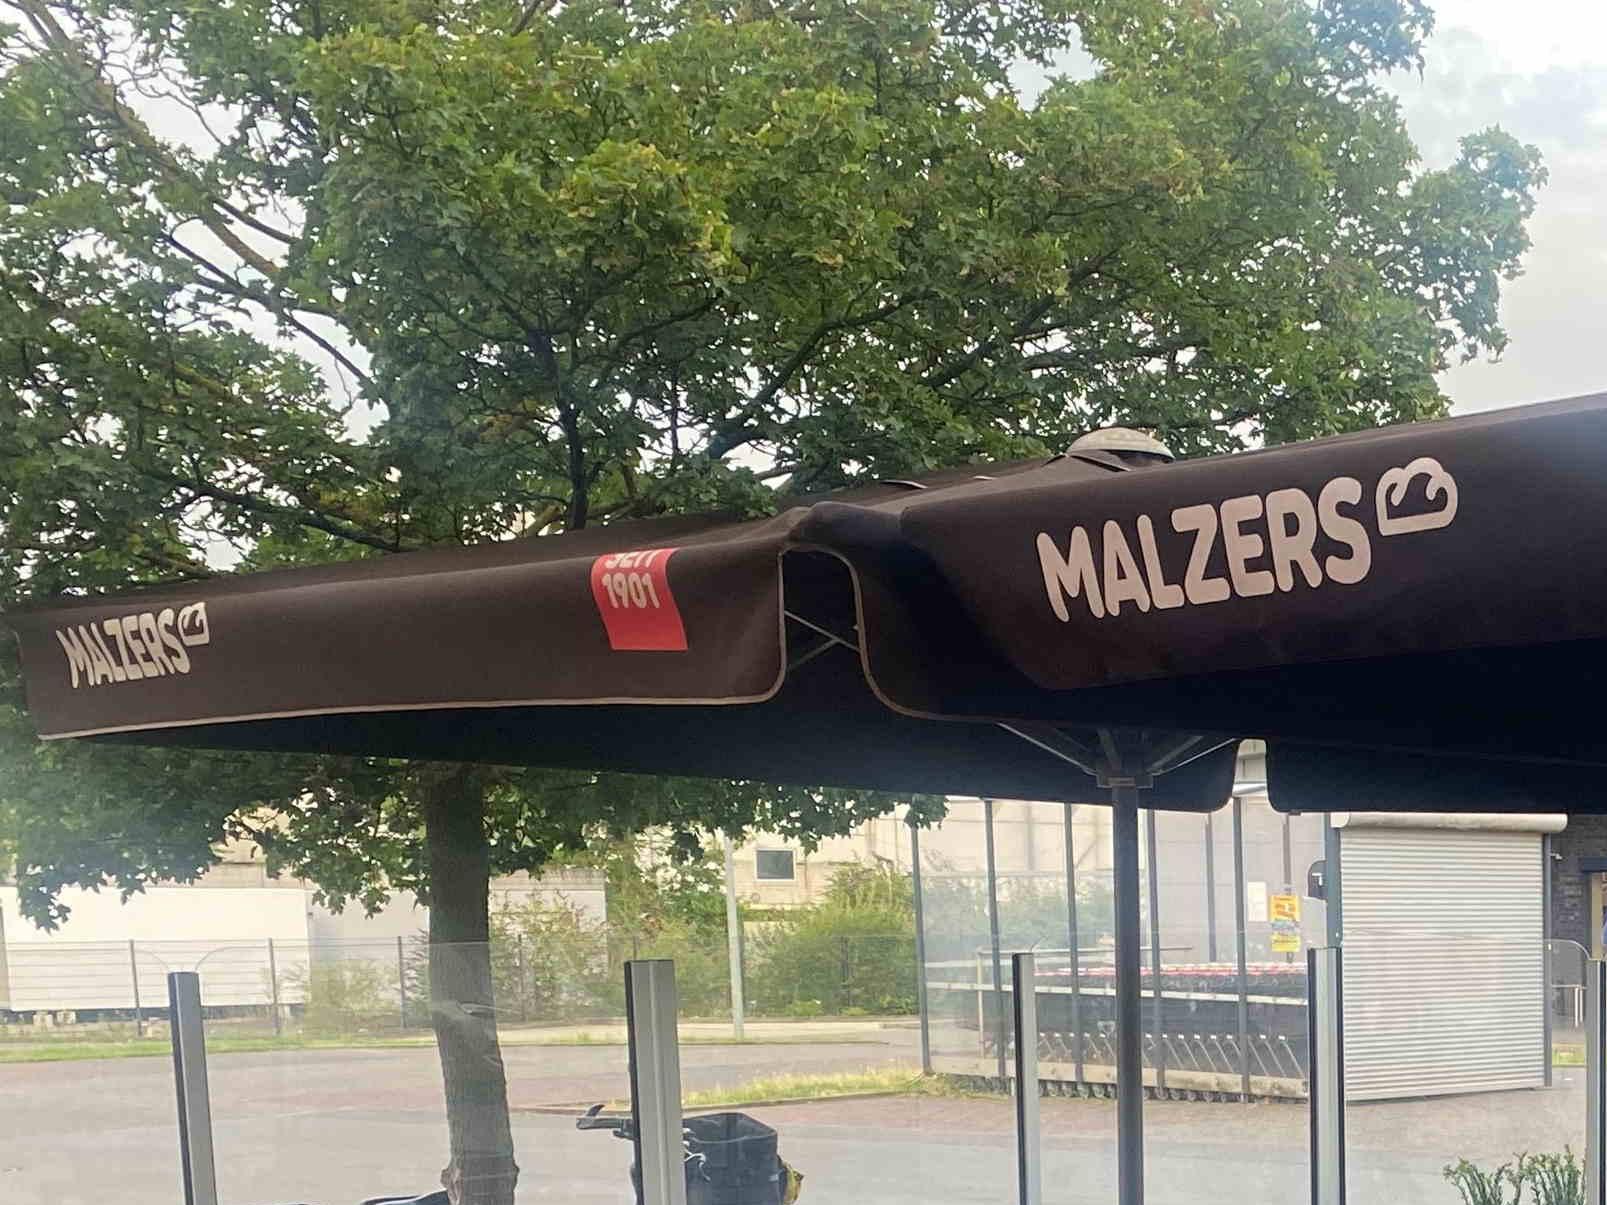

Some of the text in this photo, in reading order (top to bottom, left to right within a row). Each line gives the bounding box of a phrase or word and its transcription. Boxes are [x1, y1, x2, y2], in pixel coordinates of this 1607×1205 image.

[1036, 476, 1372, 622] MALZERS
[602, 572, 660, 609] 1901
[56, 608, 191, 689] MALZERS
